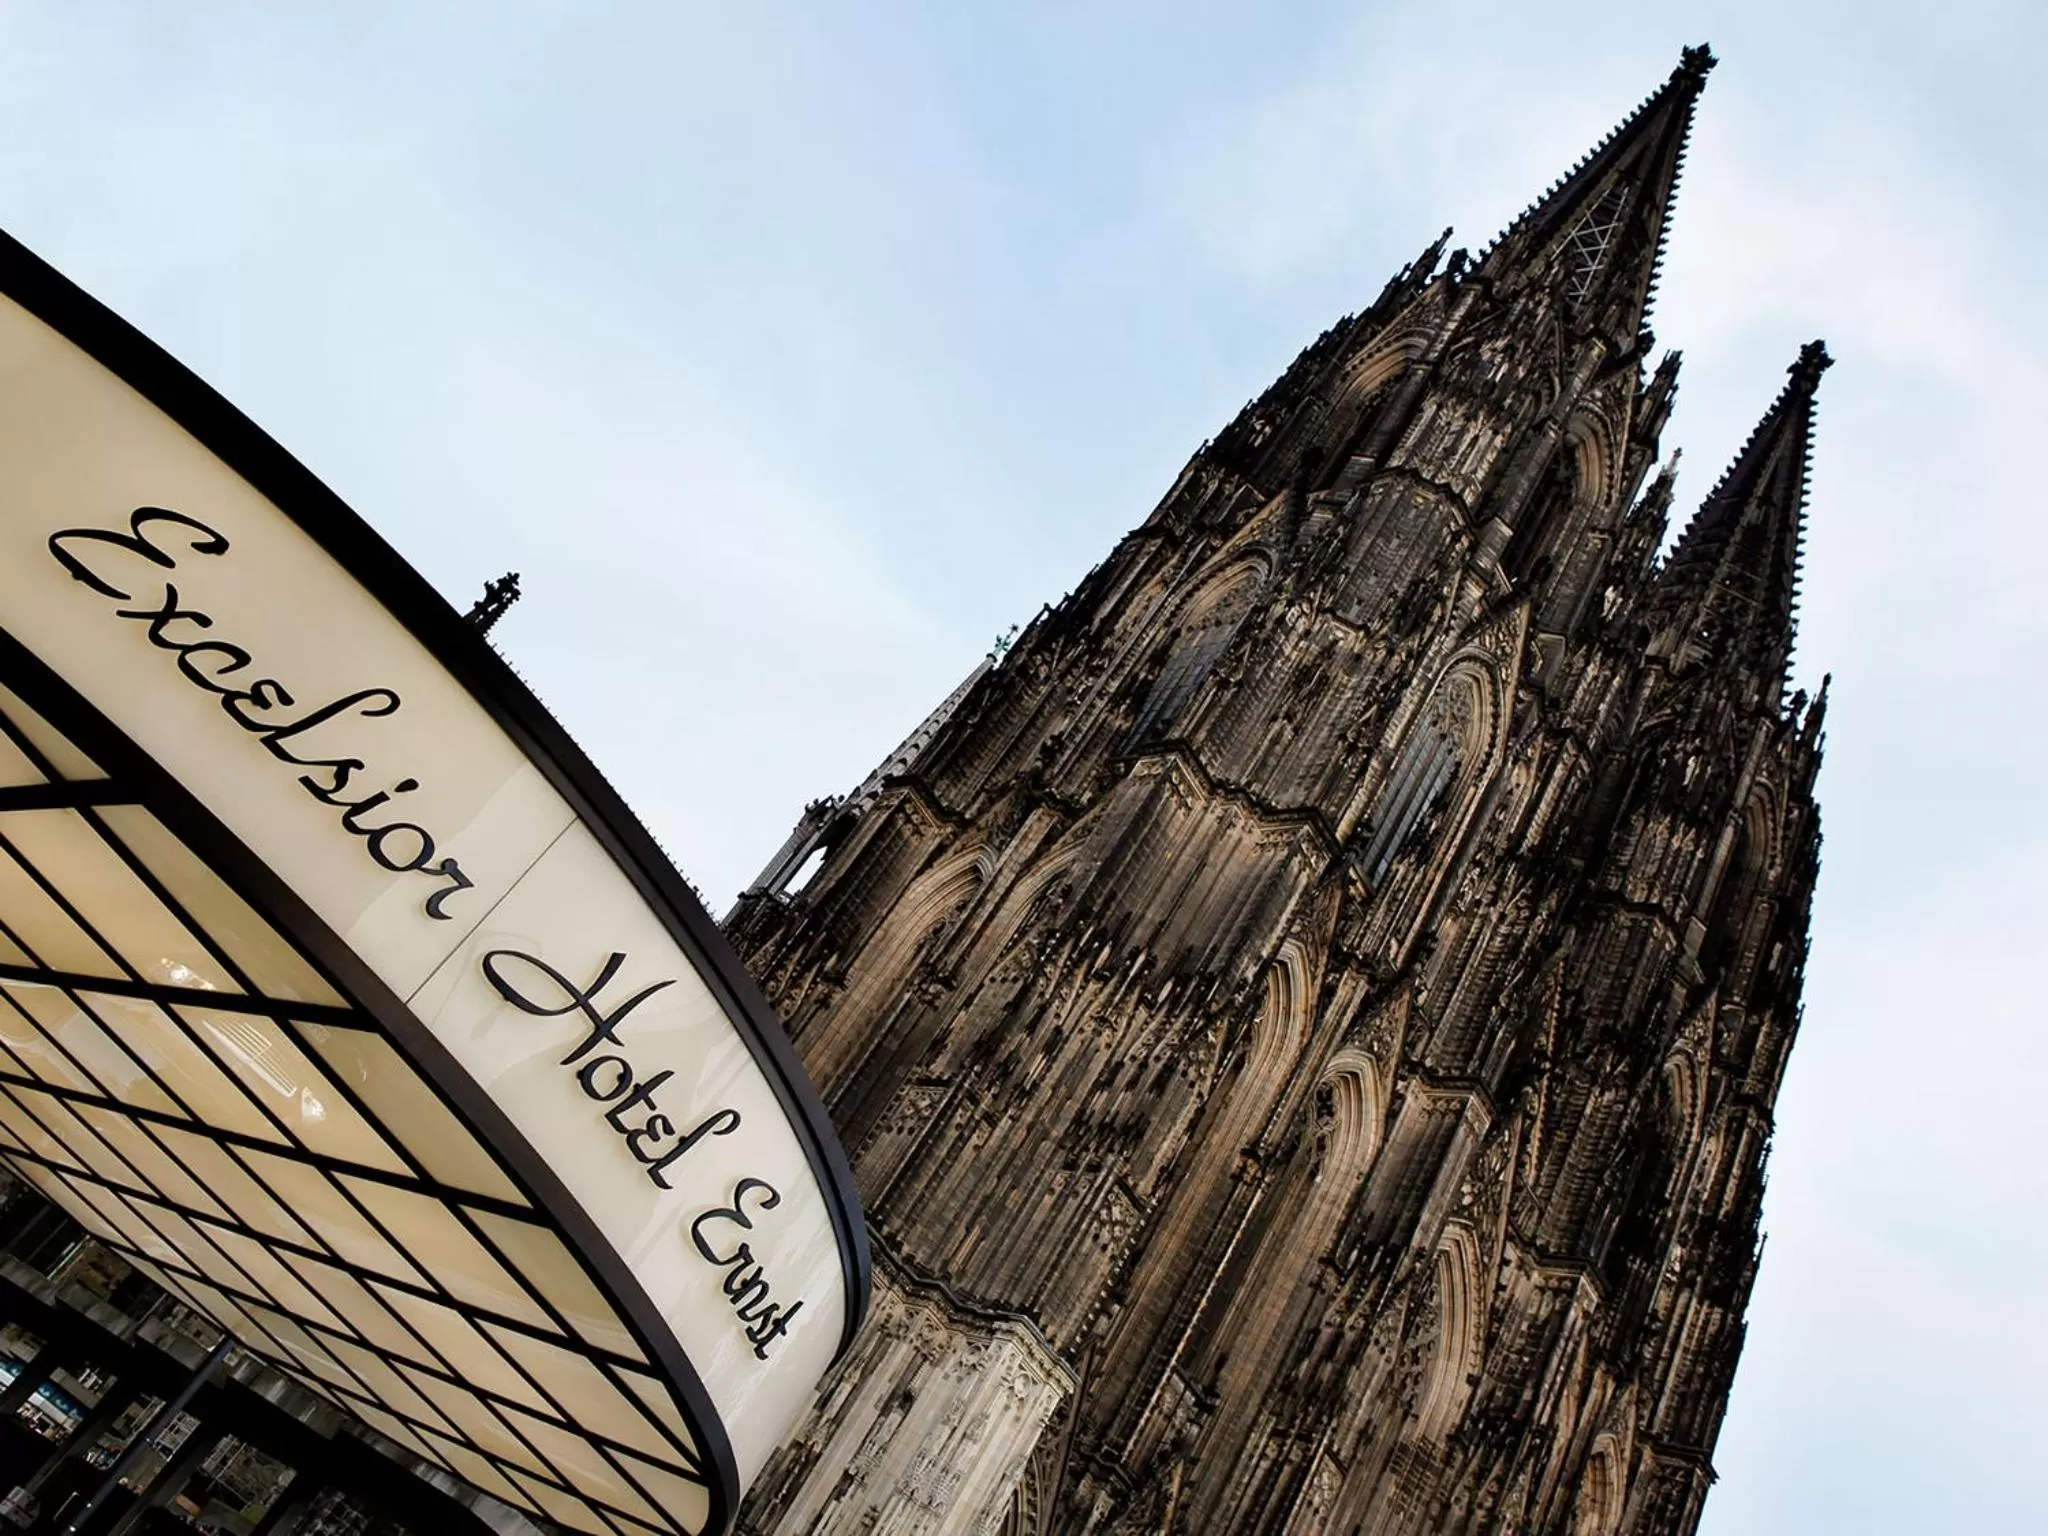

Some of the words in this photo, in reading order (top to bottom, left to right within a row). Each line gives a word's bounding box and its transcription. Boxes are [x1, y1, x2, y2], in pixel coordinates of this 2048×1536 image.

[48, 506, 475, 921] Excelsior
[482, 950, 741, 1190] Hotel
[690, 1178, 804, 1361] Ernst
